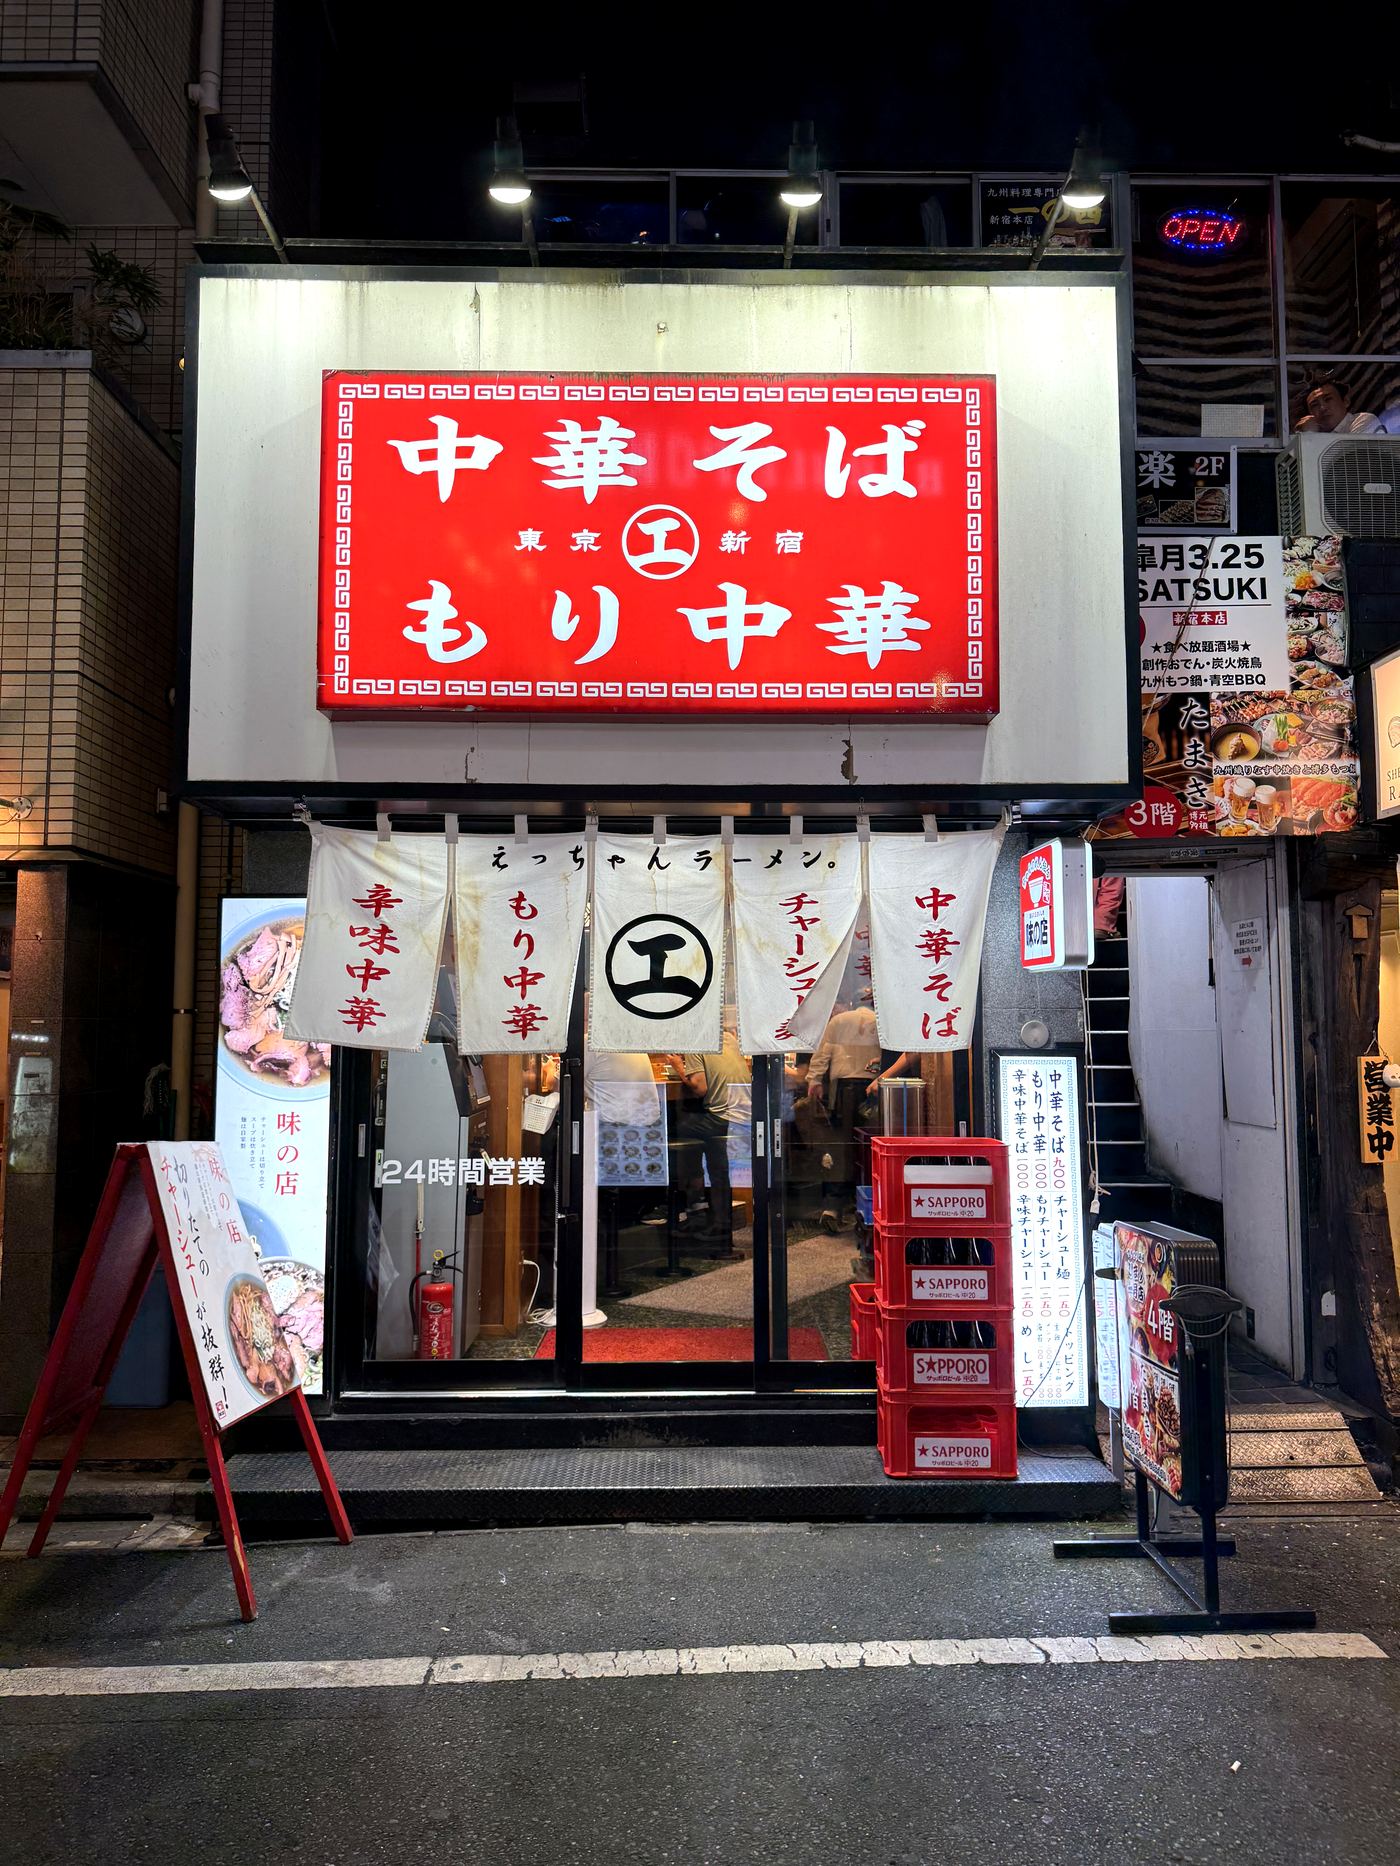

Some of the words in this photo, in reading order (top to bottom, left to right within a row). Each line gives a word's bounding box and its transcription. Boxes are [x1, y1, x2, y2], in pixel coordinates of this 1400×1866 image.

[989, 215, 1034, 225] 新宿本店
[1164, 218, 1241, 243] OPEN
[386, 414, 926, 504] 中華そば
[1137, 450, 1177, 489] 楽
[1194, 456, 1225, 476] 2F
[514, 528, 602, 553] 東京
[720, 528, 803, 554] 新宿
[401, 579, 932, 671] もり中華
[1138, 577, 1267, 602] SATSUKI
[1173, 611, 1227, 625] 新宿本店
[1178, 698, 1210, 810] たまき
[1128, 799, 1177, 826] 3階
[491, 845, 837, 873] えっちゃんラーメン。
[337, 883, 404, 1034] 辛味中華
[501, 890, 549, 1041] もり中華
[914, 887, 962, 1040] 中華そば
[1012, 1069, 1029, 1154] 辛味中華そば
[1032, 1070, 1047, 1154] もり中華
[1049, 1069, 1066, 1154] 中華そば
[1363, 1059, 1395, 1161] 営業中
[274, 1111, 301, 1196] 味の店
[381, 1157, 546, 1187] 24時間営業
[173, 1154, 210, 1278] 切りたての
[208, 1156, 242, 1245] 味の店
[927, 1196, 984, 1208] SAPPORO
[1016, 1194, 1032, 1281] 辛味チャーシュー
[1036, 1194, 1052, 1281] もりチャーシュー
[928, 1278, 986, 1290] SAPPORO
[1147, 1299, 1175, 1343] 4階
[1064, 1327, 1075, 1392] トッピング
[931, 1445, 989, 1458] SAPPORO
